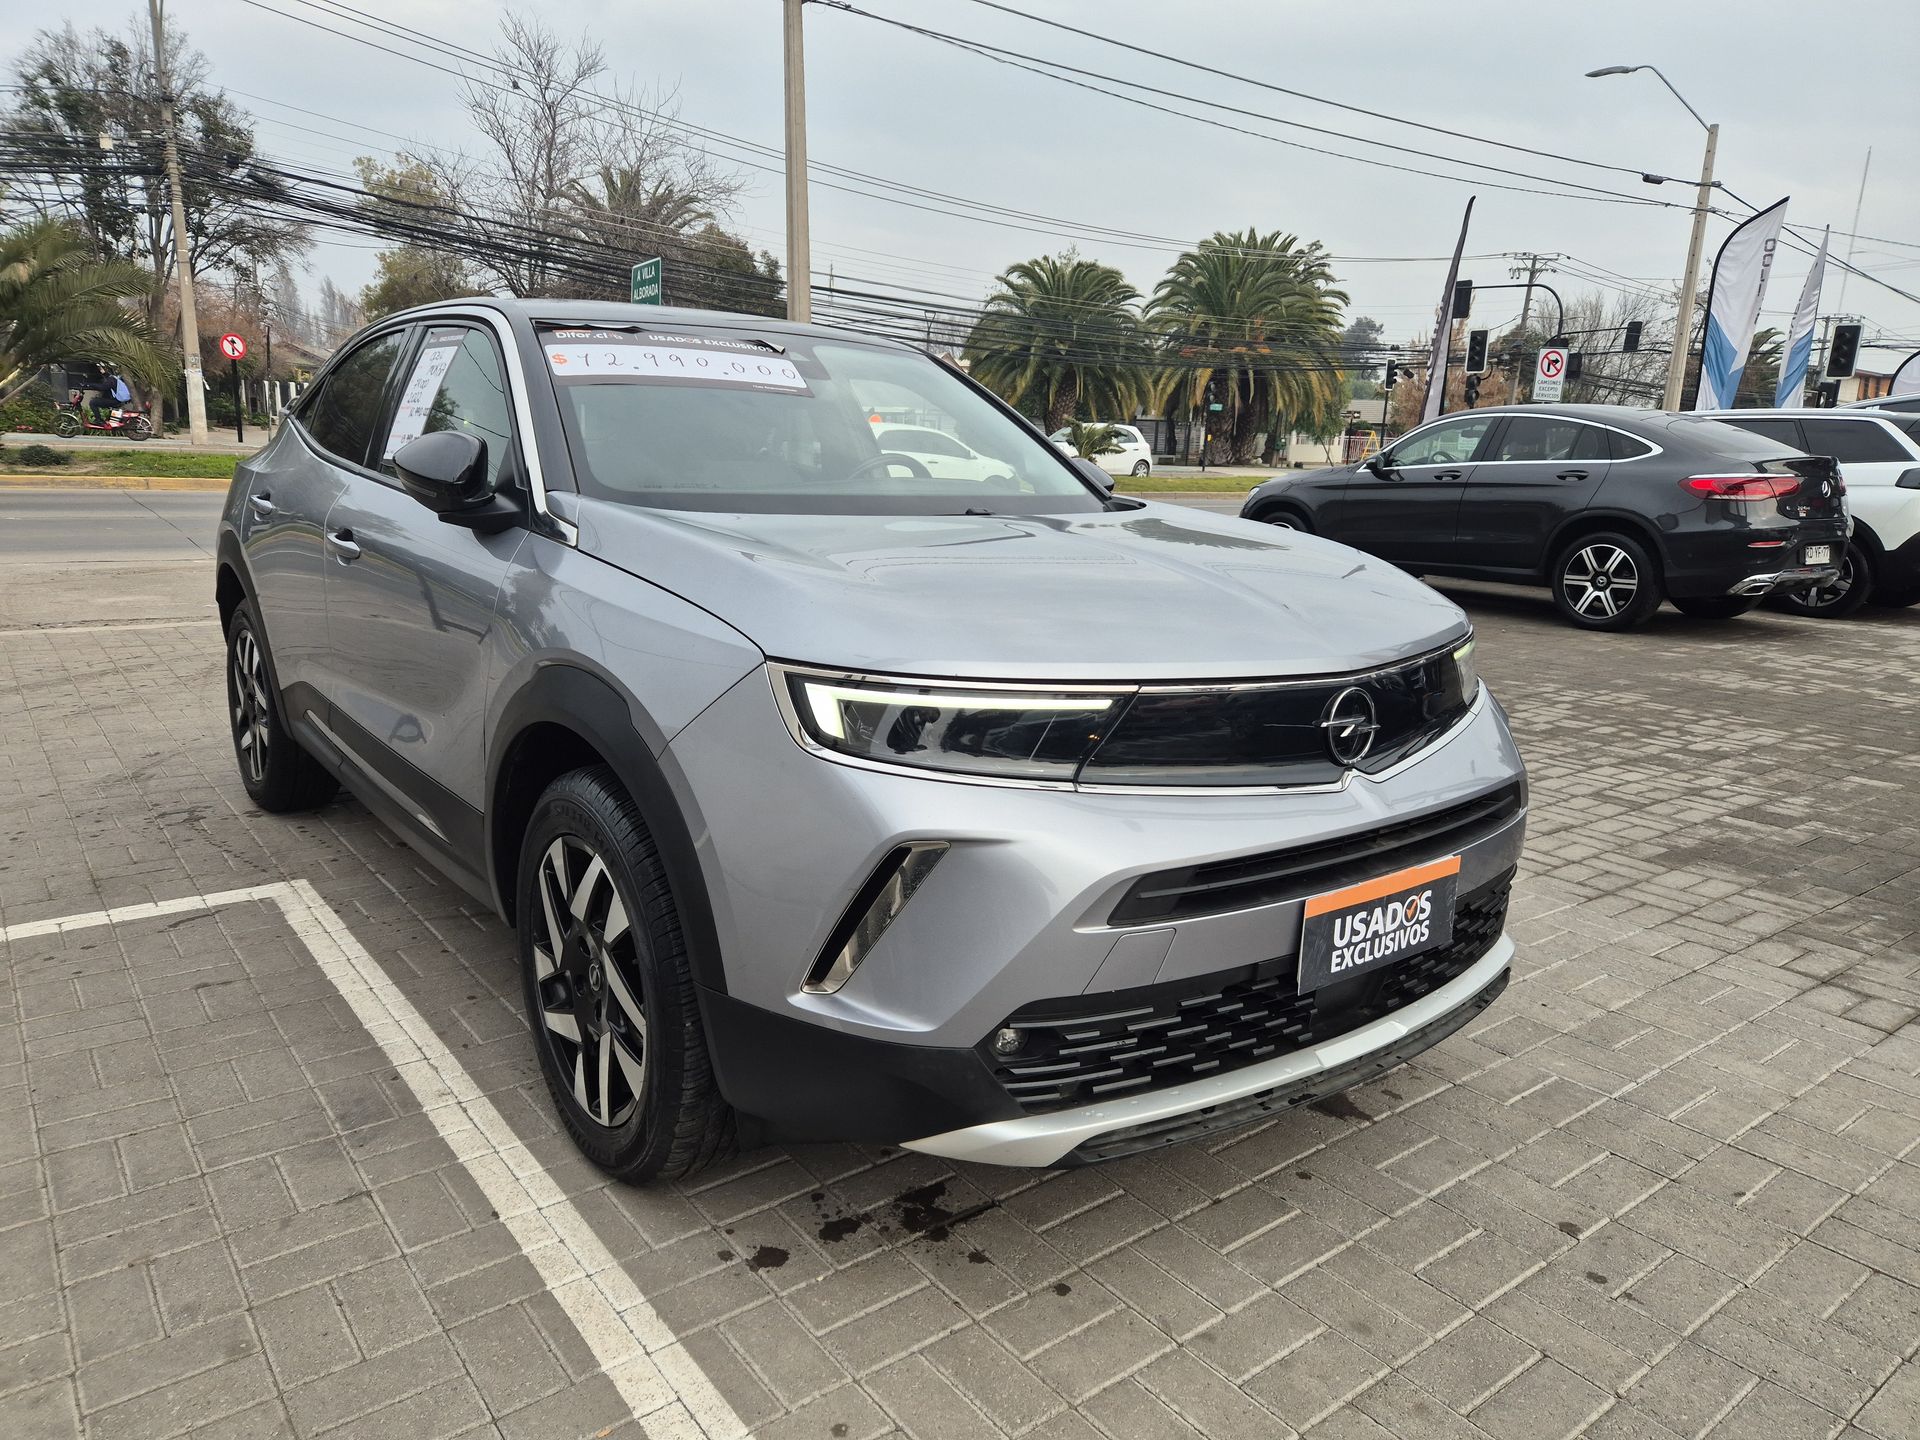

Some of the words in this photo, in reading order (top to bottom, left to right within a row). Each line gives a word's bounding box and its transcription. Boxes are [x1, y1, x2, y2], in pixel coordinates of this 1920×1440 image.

[551, 353, 568, 365] $
[648, 334, 702, 345] USADOS
[703, 339, 774, 352] EXCLUSIVOS
[1333, 889, 1432, 948] USADOS
[1330, 920, 1430, 973] EXCLUSIVOS
